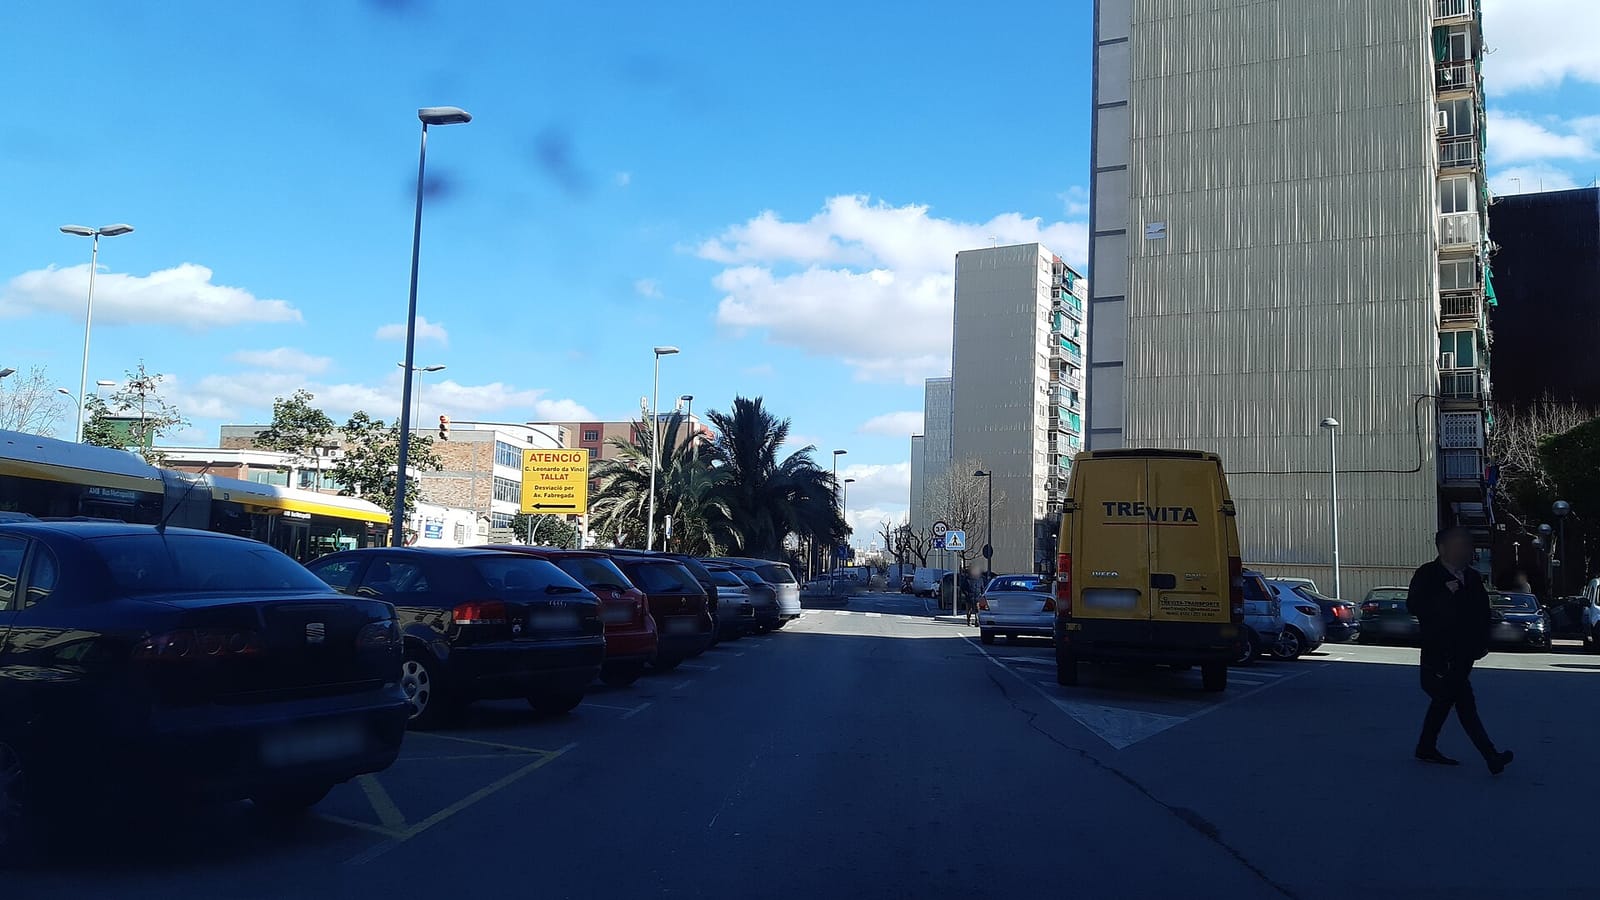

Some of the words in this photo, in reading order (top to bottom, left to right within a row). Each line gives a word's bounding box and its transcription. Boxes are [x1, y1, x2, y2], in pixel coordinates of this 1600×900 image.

[529, 452, 582, 463] ATENCIÓ
[540, 473, 569, 481] TALLAT
[1102, 501, 1198, 522] TREVITA
